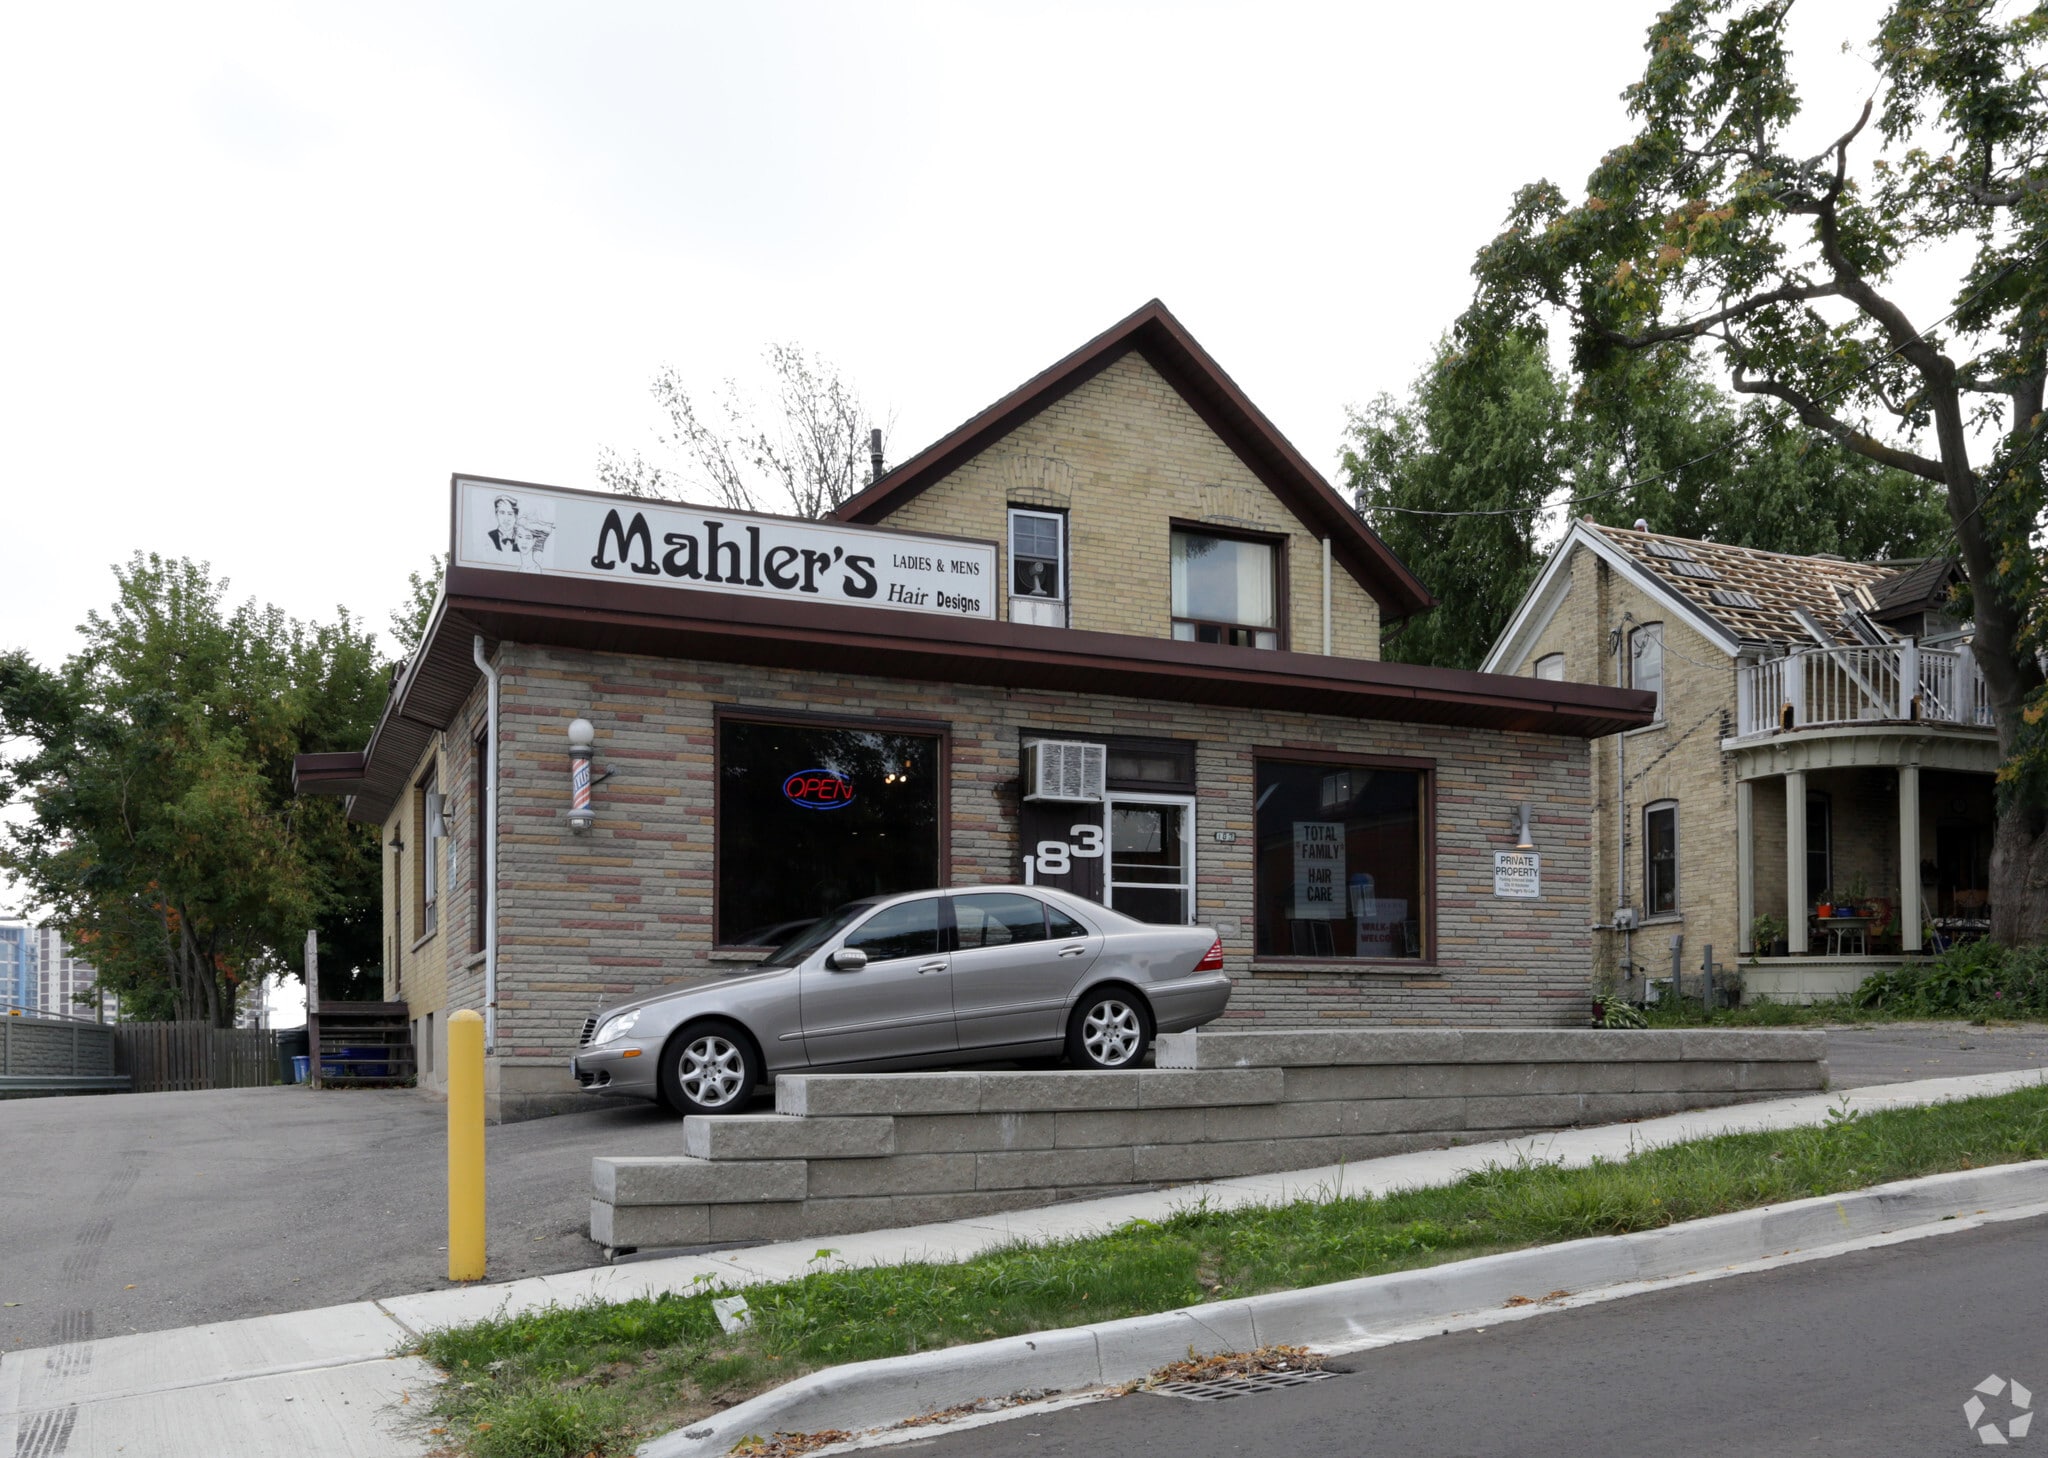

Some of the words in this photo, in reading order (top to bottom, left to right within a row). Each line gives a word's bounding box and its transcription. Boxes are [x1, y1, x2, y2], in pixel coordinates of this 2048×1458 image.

[591, 508, 878, 599] Mahler's
[893, 554, 932, 571] LADIES
[936, 558, 945, 573] &
[950, 560, 980, 576] MENS
[887, 583, 929, 606] Hair
[937, 590, 980, 613] Designs
[786, 777, 853, 799] OPEN
[1303, 825, 1338, 842] TOTAL
[1302, 843, 1339, 859] FAMILY
[1500, 855, 1534, 867] PRIVATE
[1308, 868, 1332, 884] HAIR
[1495, 866, 1538, 877] PROPERTY
[1307, 886, 1333, 902] CARE
